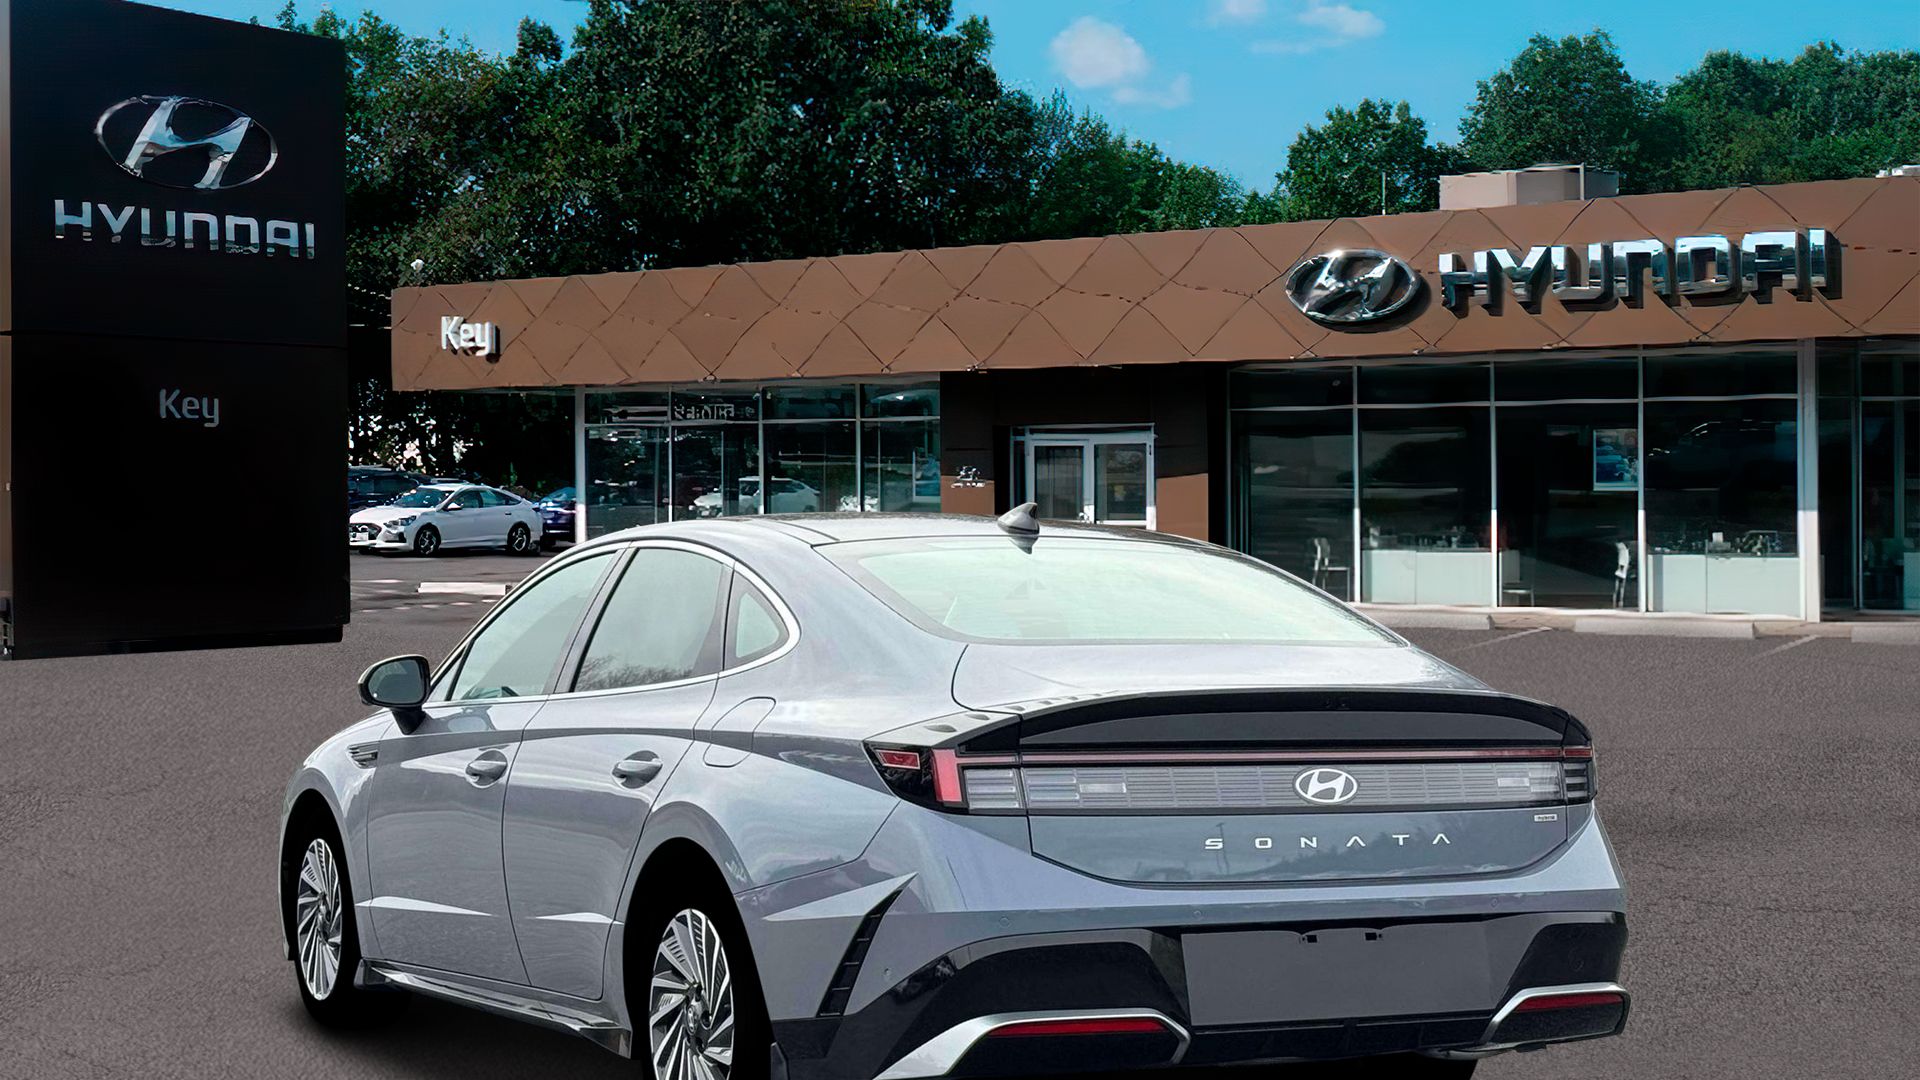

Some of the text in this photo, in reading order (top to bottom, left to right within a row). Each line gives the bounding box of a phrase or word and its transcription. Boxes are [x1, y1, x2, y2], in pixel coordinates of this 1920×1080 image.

[54, 199, 315, 260] HYUNDAI
[1439, 229, 1838, 309] HYUNDAI
[441, 315, 493, 357] Key
[159, 388, 220, 428] Key
[1204, 833, 1451, 850] SONATA
